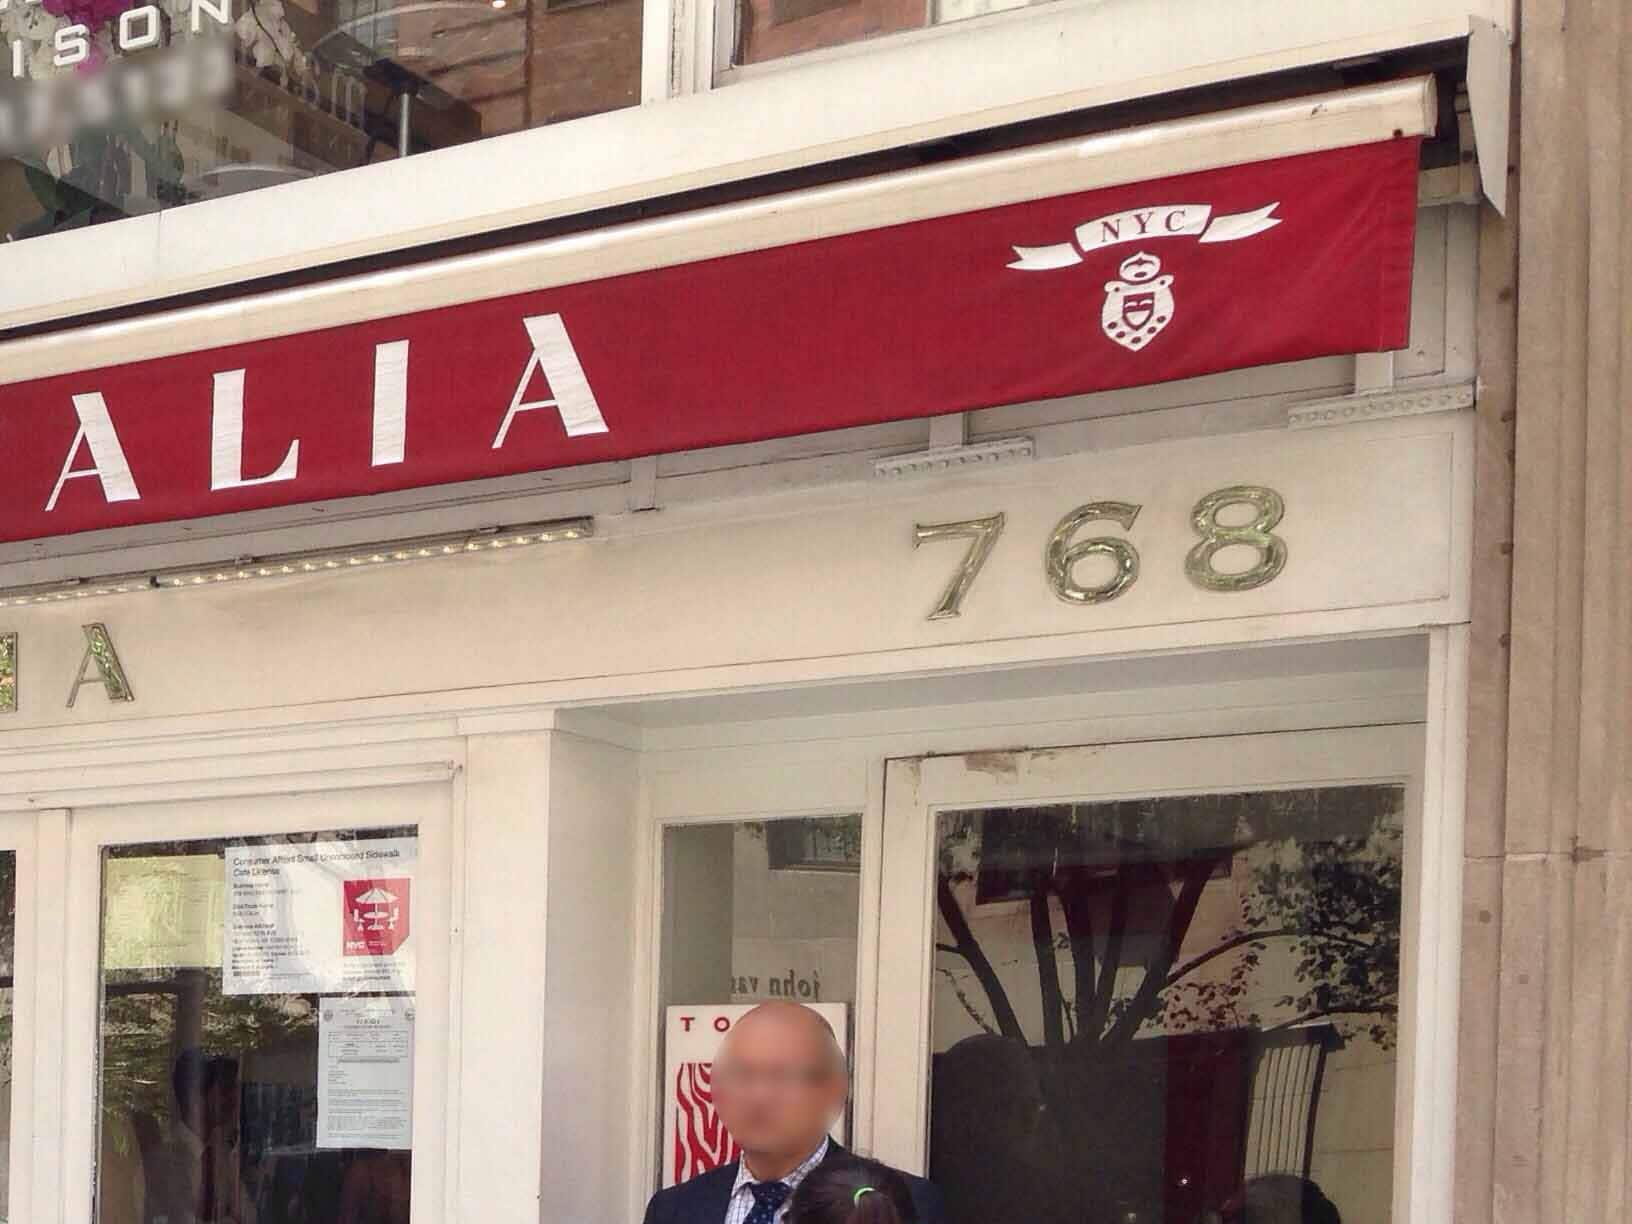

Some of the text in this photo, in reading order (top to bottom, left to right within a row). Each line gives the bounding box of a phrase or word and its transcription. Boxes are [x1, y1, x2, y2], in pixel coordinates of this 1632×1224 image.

[1100, 209, 1187, 243] NYC
[911, 485, 1288, 620] 768
[680, 1016, 731, 1033] TO
